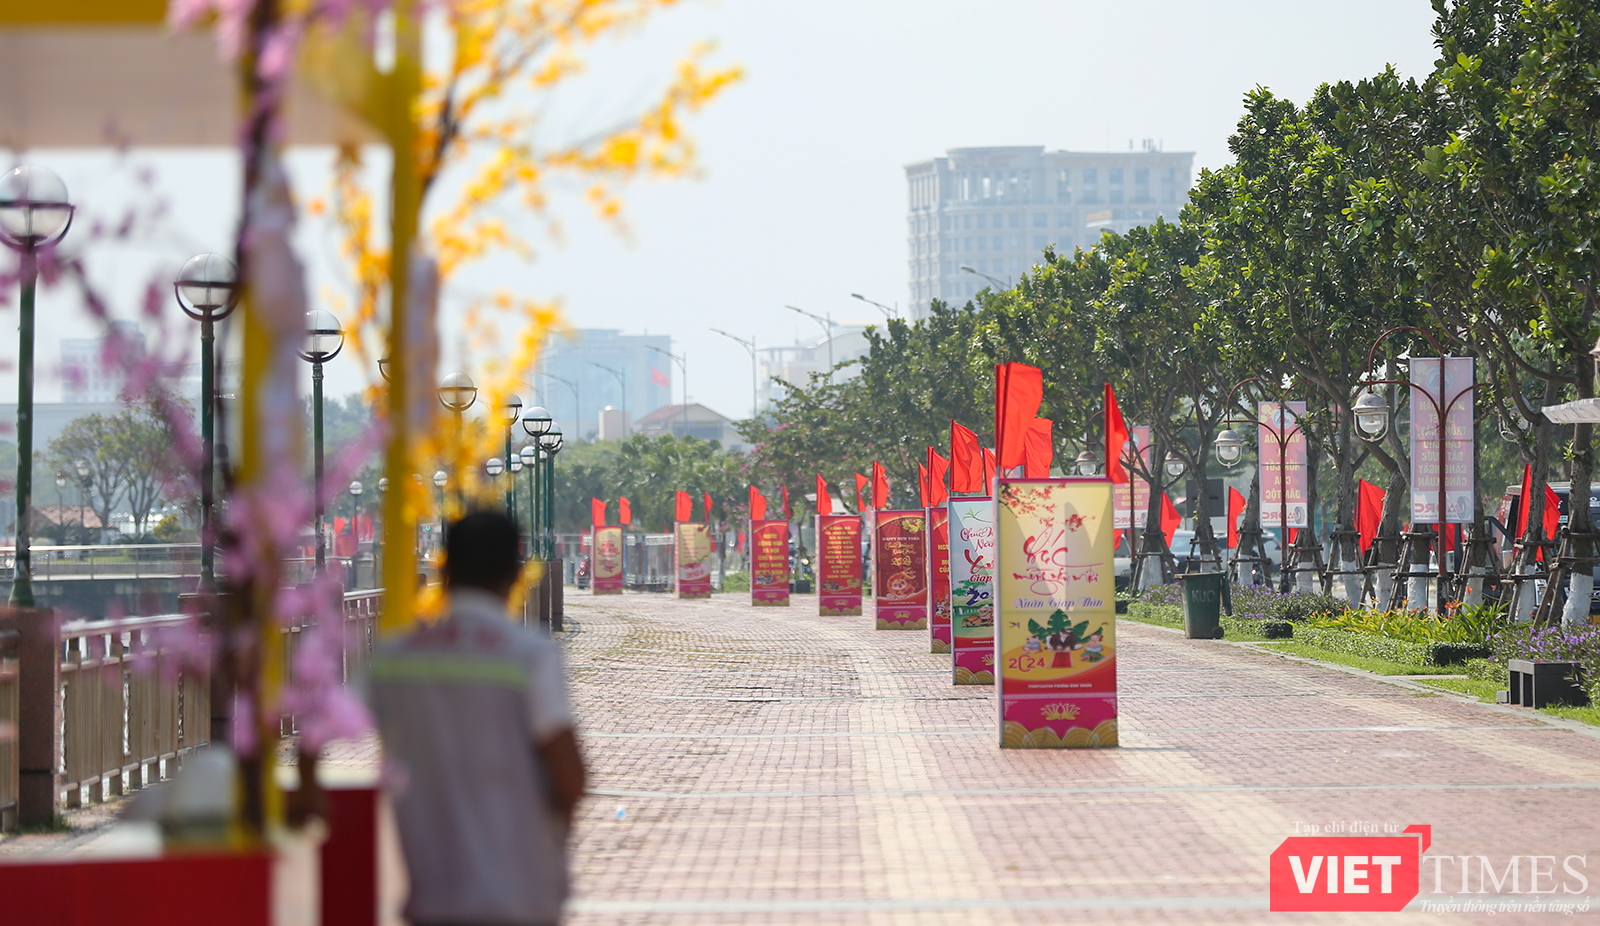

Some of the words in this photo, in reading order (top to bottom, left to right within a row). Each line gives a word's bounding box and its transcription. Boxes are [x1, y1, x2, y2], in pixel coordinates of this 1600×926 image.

[1013, 598, 1045, 609] Xuân
[1048, 598, 1075, 611] Giáp
[1008, 654, 1046, 672] 2024
